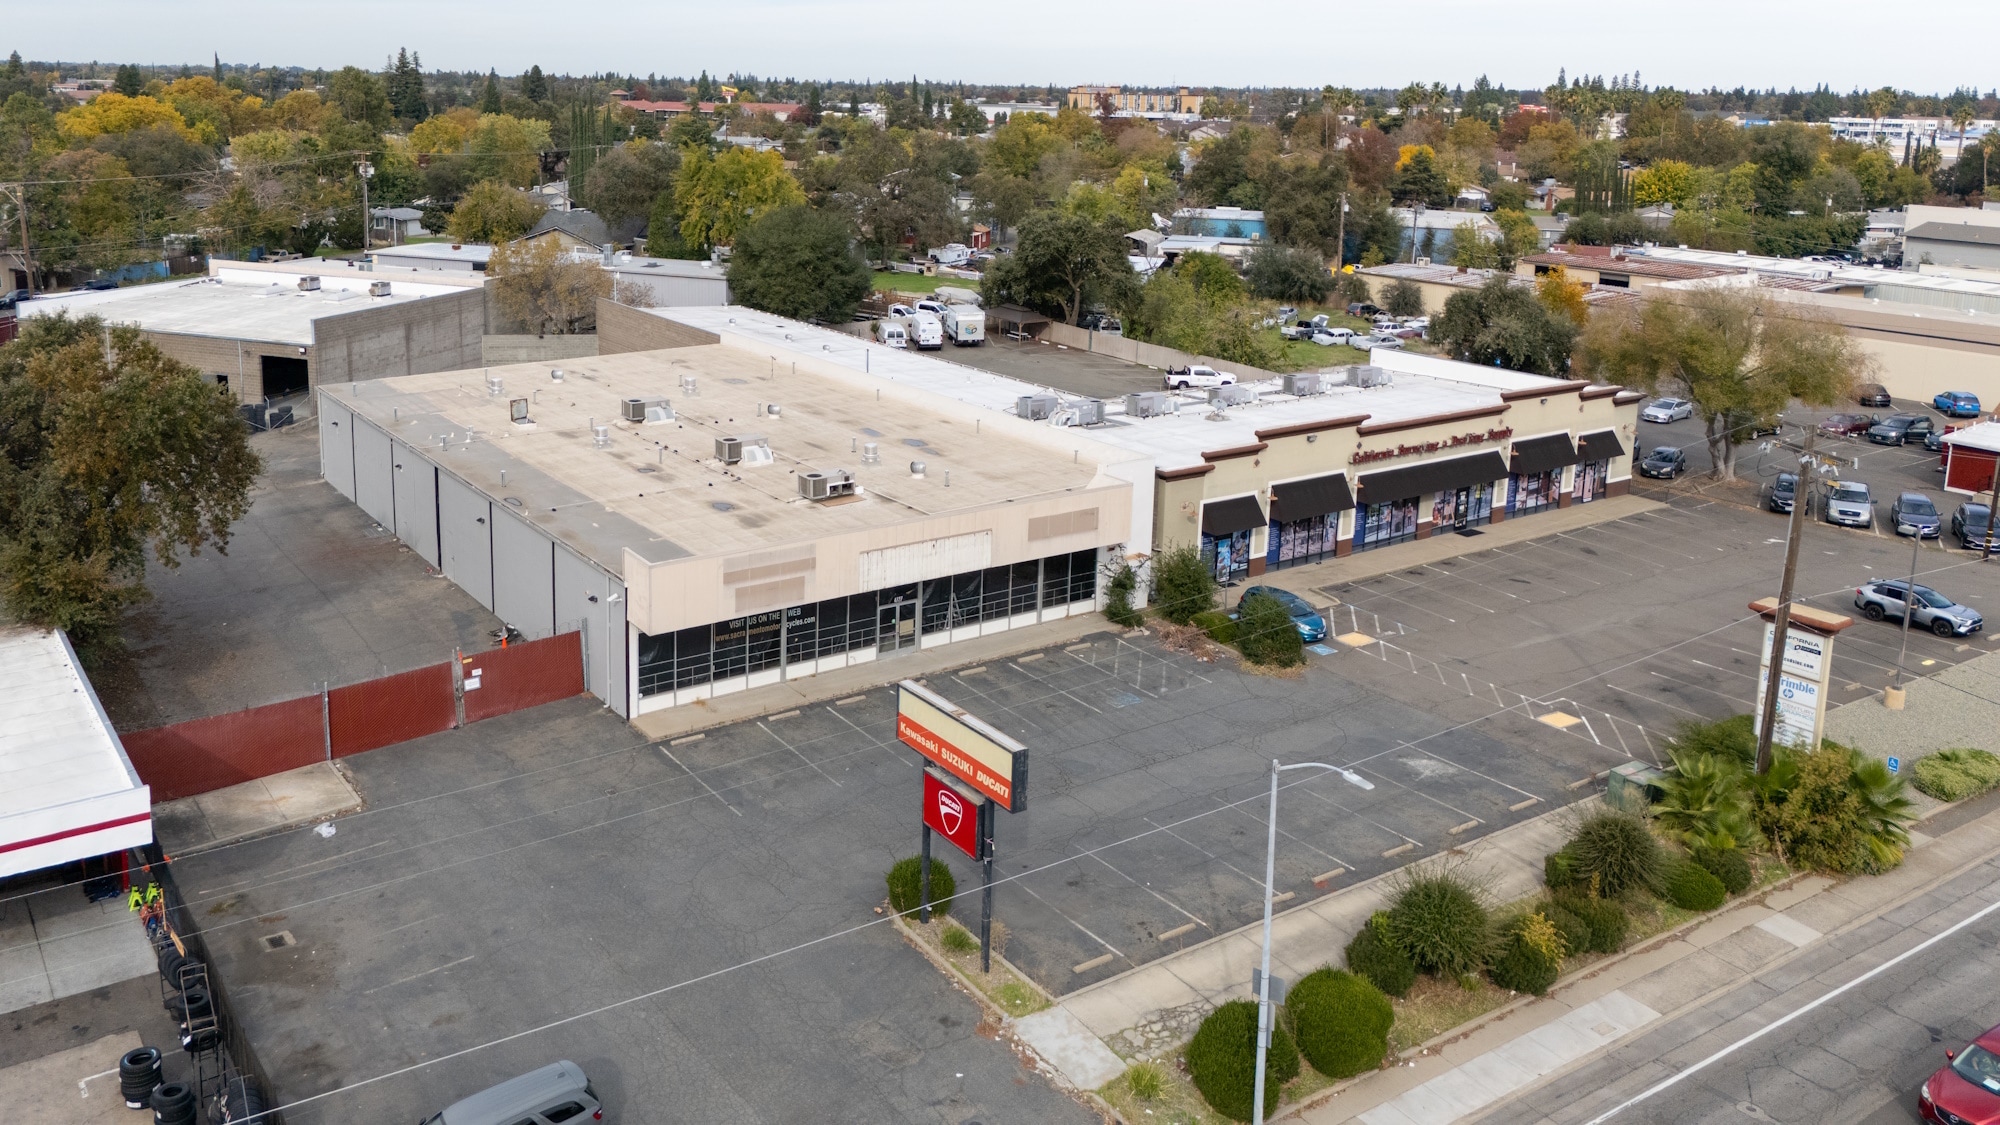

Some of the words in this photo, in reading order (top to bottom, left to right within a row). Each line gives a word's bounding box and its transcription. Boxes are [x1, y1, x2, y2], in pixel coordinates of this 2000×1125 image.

[729, 619, 745, 629] VISIT
[748, 616, 757, 625] US
[758, 614, 767, 623] ON
[769, 611, 781, 620] THE
[787, 607, 801, 617] WEB
[1780, 676, 1815, 695] rimble
[900, 721, 938, 754] Kawasaki
[941, 749, 973, 776] SUZUKI
[976, 770, 1009, 799] DUCATI
[941, 795, 961, 813] DUCATI
